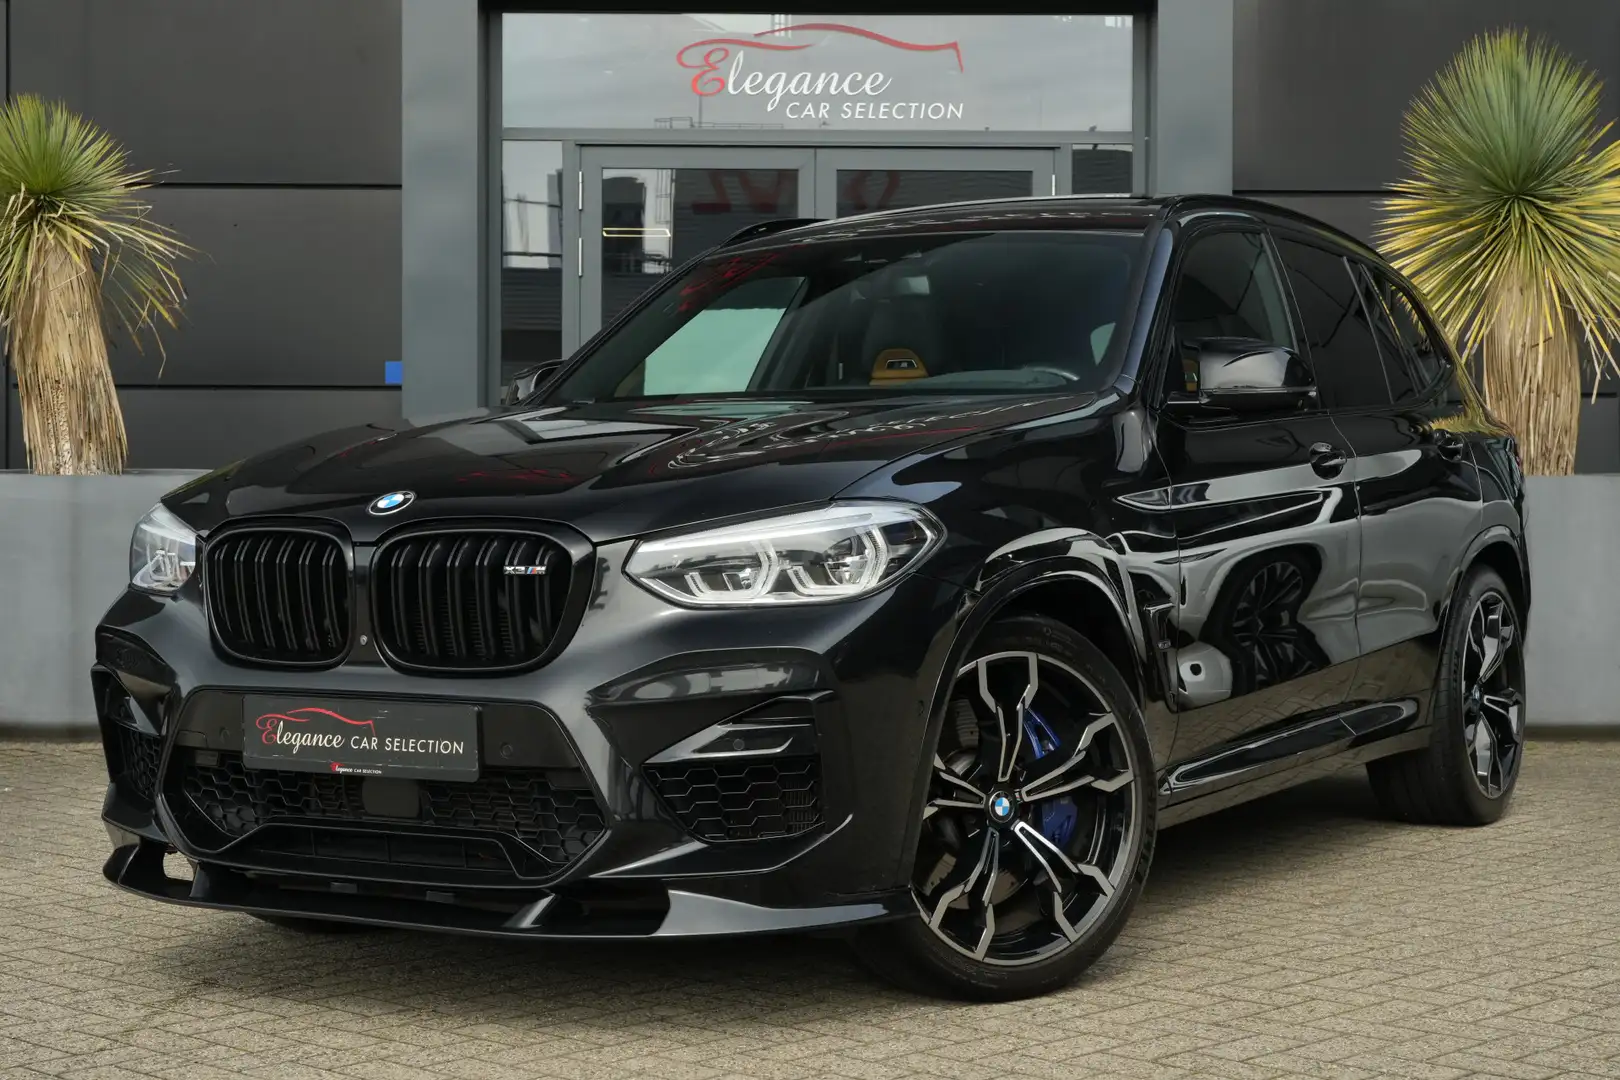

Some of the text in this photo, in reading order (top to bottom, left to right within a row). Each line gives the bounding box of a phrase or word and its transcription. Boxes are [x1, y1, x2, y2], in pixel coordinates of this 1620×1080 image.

[677, 40, 892, 112] Elegance
[786, 102, 964, 119] CAR SELECTION
[256, 714, 465, 755] Elegance CAR SELECTION
